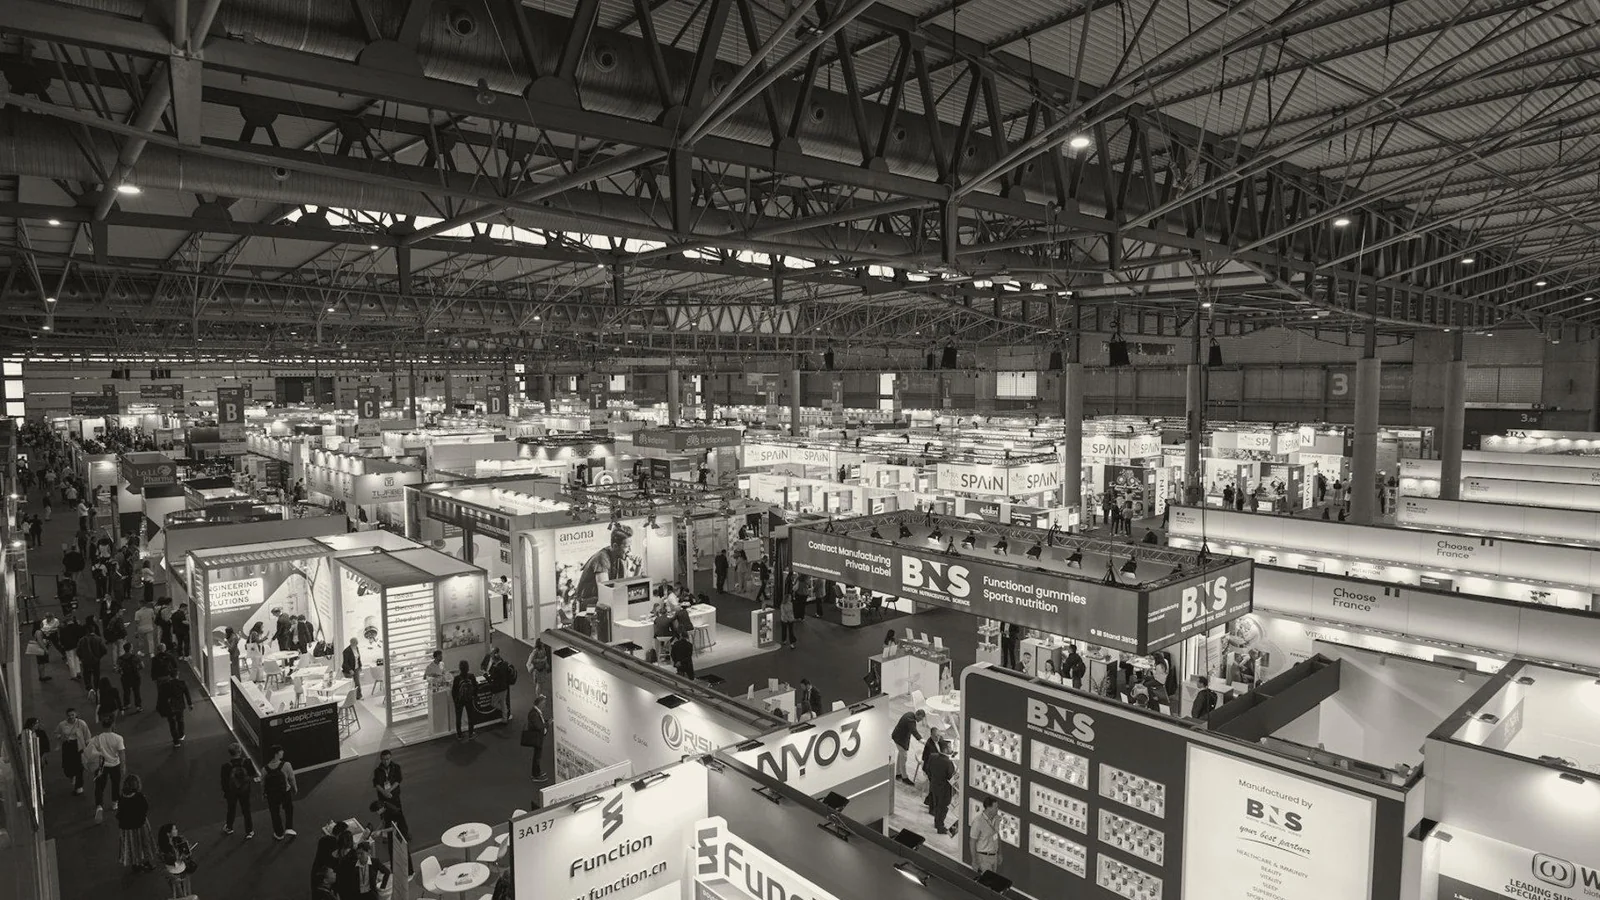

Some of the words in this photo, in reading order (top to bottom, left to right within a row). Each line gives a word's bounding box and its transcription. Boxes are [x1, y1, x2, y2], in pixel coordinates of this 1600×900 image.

[1332, 373, 1348, 395] 3
[491, 397, 500, 413] D
[595, 393, 602, 408] F
[686, 392, 692, 406] G
[769, 391, 775, 404] H
[225, 403, 238, 422] B
[364, 400, 374, 418] C
[143, 475, 174, 484] Pharma
[559, 529, 594, 542] anona
[808, 540, 838, 554] Contract
[838, 546, 891, 568] Manufacturing
[1436, 548, 1470, 559] France
[1437, 540, 1474, 552] Choose
[845, 558, 871, 572] Private
[871, 564, 892, 577] Label
[902, 554, 971, 598] BNS
[209, 588, 251, 600] TURNKEY
[983, 575, 1034, 595] Functional
[1035, 587, 1088, 606] gummies
[1181, 575, 1228, 625] BNS
[1333, 587, 1377, 603] Choose
[983, 588, 1014, 604] Sports
[1015, 596, 1059, 614] nutrition
[1332, 597, 1371, 612] France
[1102, 630, 1121, 641] Stand
[1027, 696, 1095, 743] BNS
[1238, 778, 1300, 805] Manufactured
[1301, 798, 1313, 810] by
[1246, 797, 1303, 832] BNS
[518, 818, 555, 840] 3A137
[1238, 824, 1258, 836] your
[1259, 830, 1277, 843] best
[1277, 838, 1311, 855] partner
[569, 834, 653, 879] Function
[1236, 848, 1272, 867] HEALTHCARE
[1279, 864, 1309, 879] IMMUNITY
[724, 842, 816, 900] Fun
[1259, 873, 1282, 885] VITALITY
[1260, 865, 1282, 878] BEAUTY
[1262, 882, 1279, 892] SLEEP
[1509, 878, 1551, 898] LEADING
